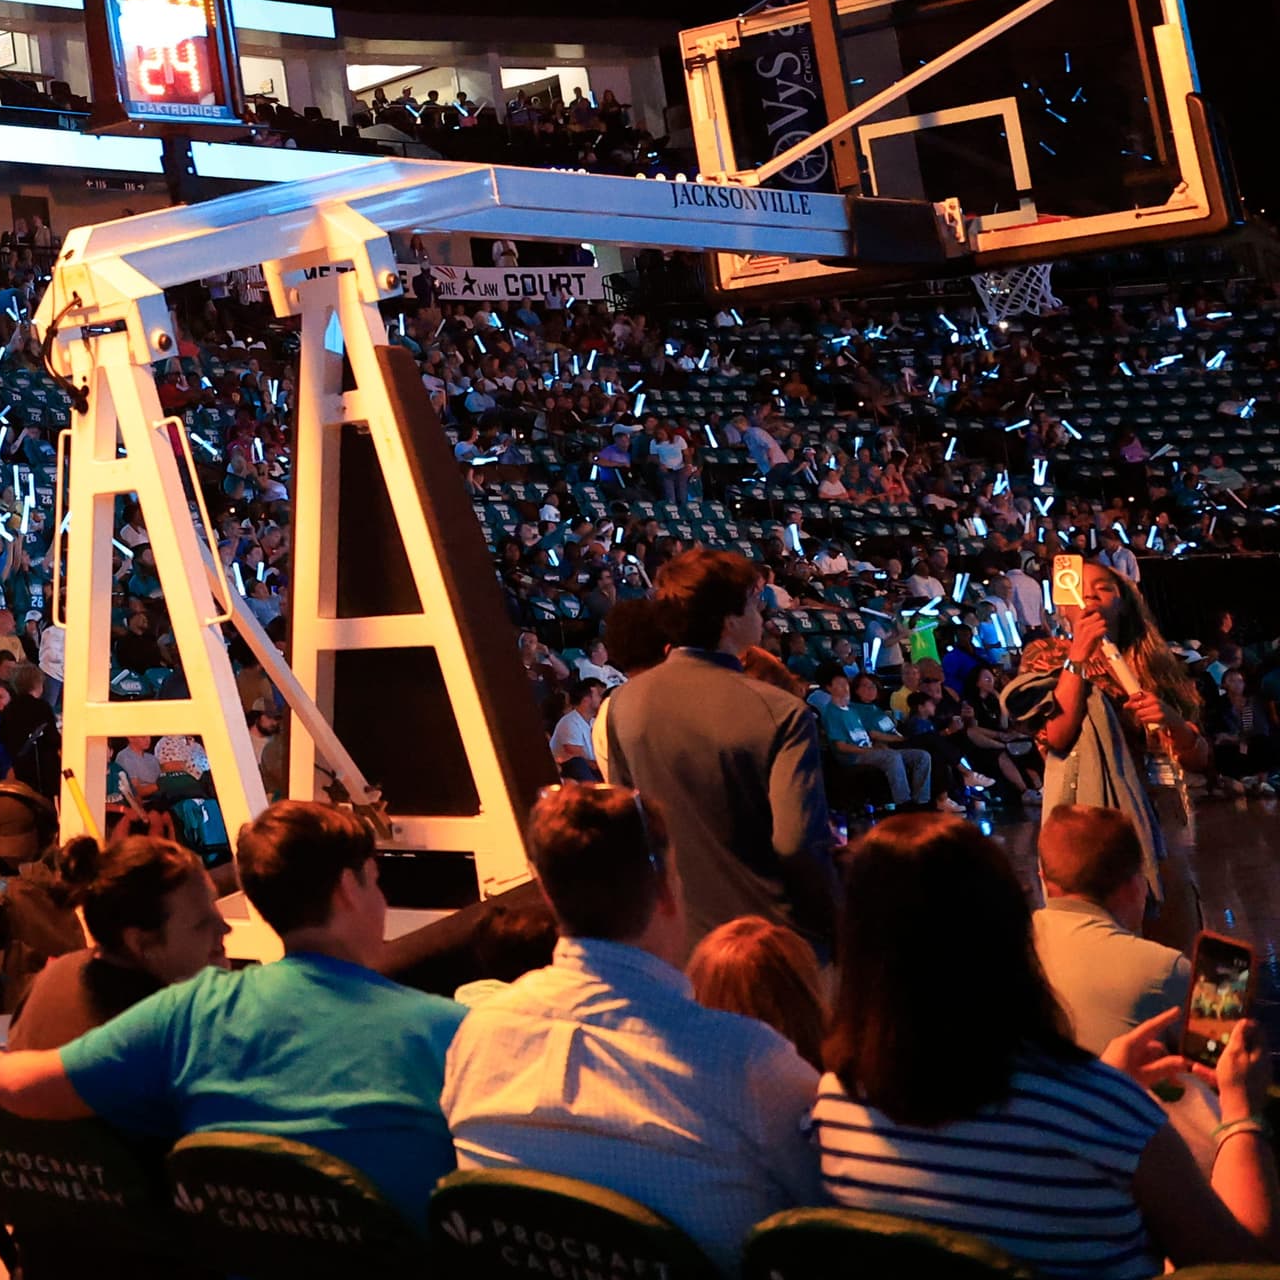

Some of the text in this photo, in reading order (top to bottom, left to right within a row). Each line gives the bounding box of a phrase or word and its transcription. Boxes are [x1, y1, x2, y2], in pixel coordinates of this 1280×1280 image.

[138, 101, 221, 118] DAKTRONICS
[670, 182, 811, 215] JACKSONVILLE
[477, 283, 498, 296] LAW
